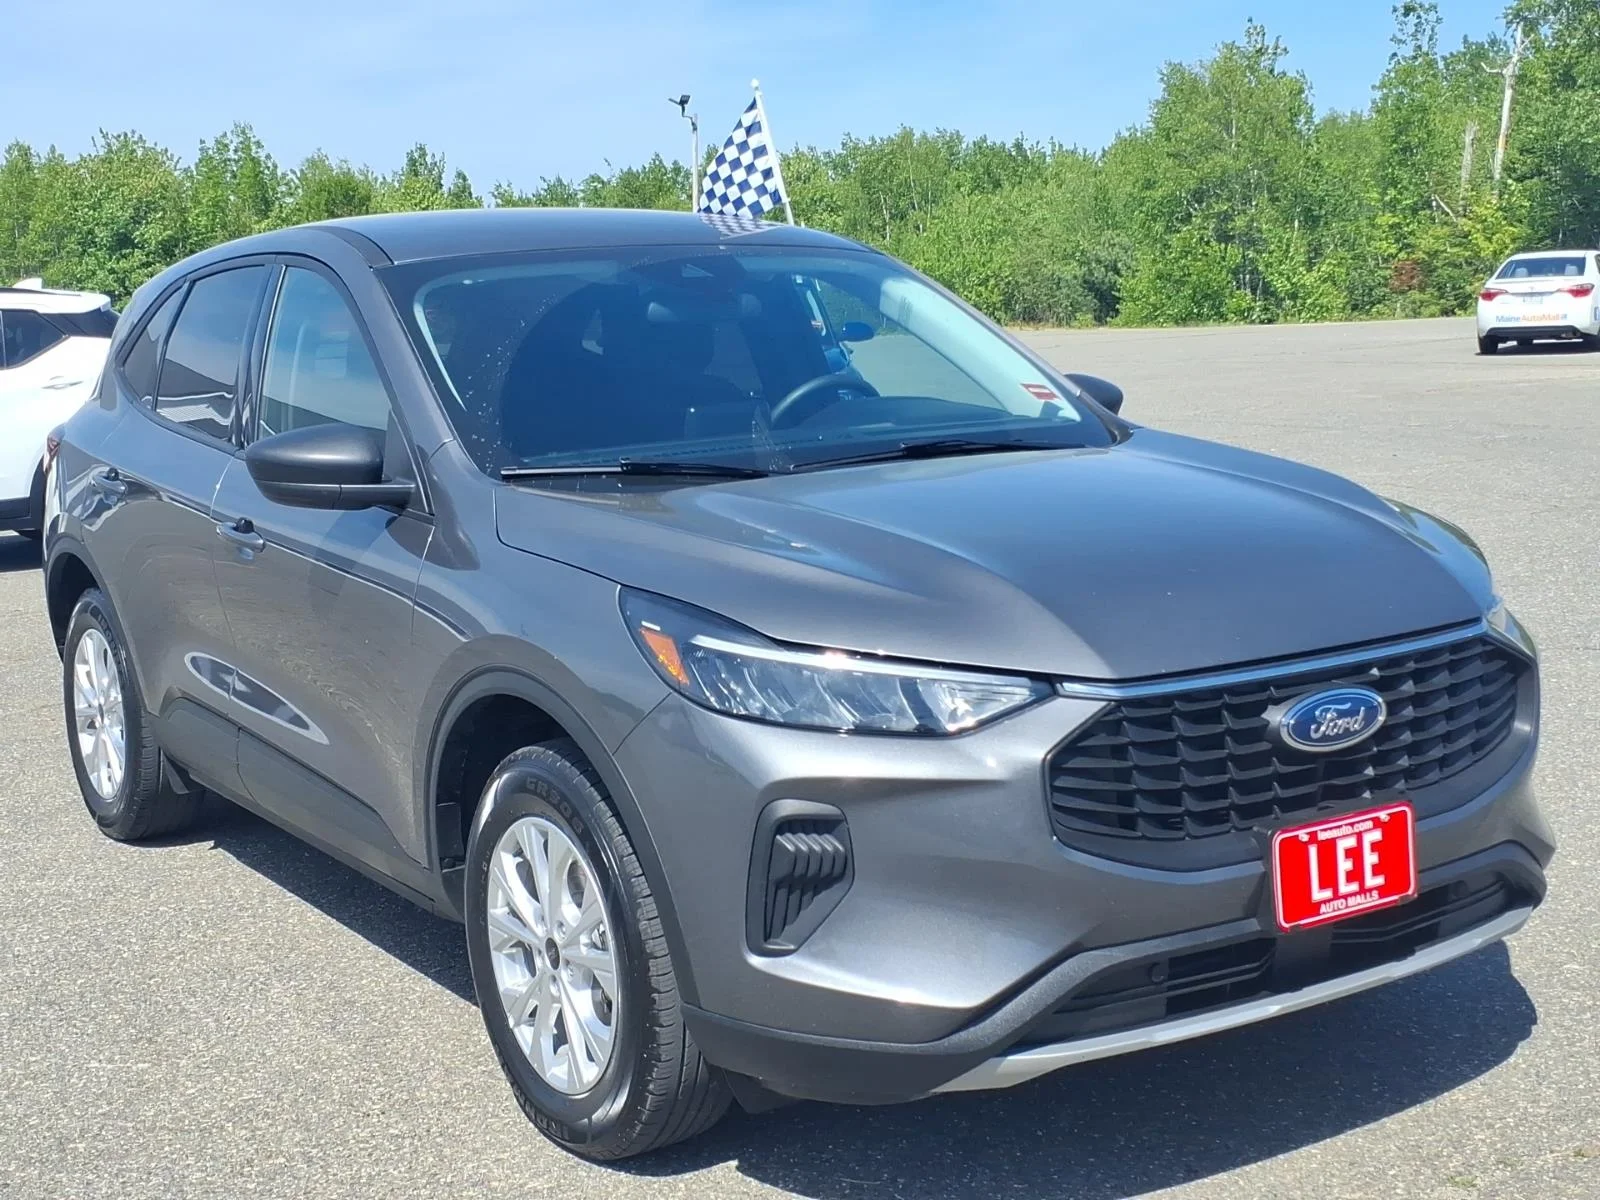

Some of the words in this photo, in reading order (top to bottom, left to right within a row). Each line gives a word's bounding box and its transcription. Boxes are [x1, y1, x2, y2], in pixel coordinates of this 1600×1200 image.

[1310, 703, 1365, 739] Ford
[1308, 828, 1385, 902] LEE
[1320, 898, 1347, 914] AUTO
[1347, 889, 1379, 907] MALLS
